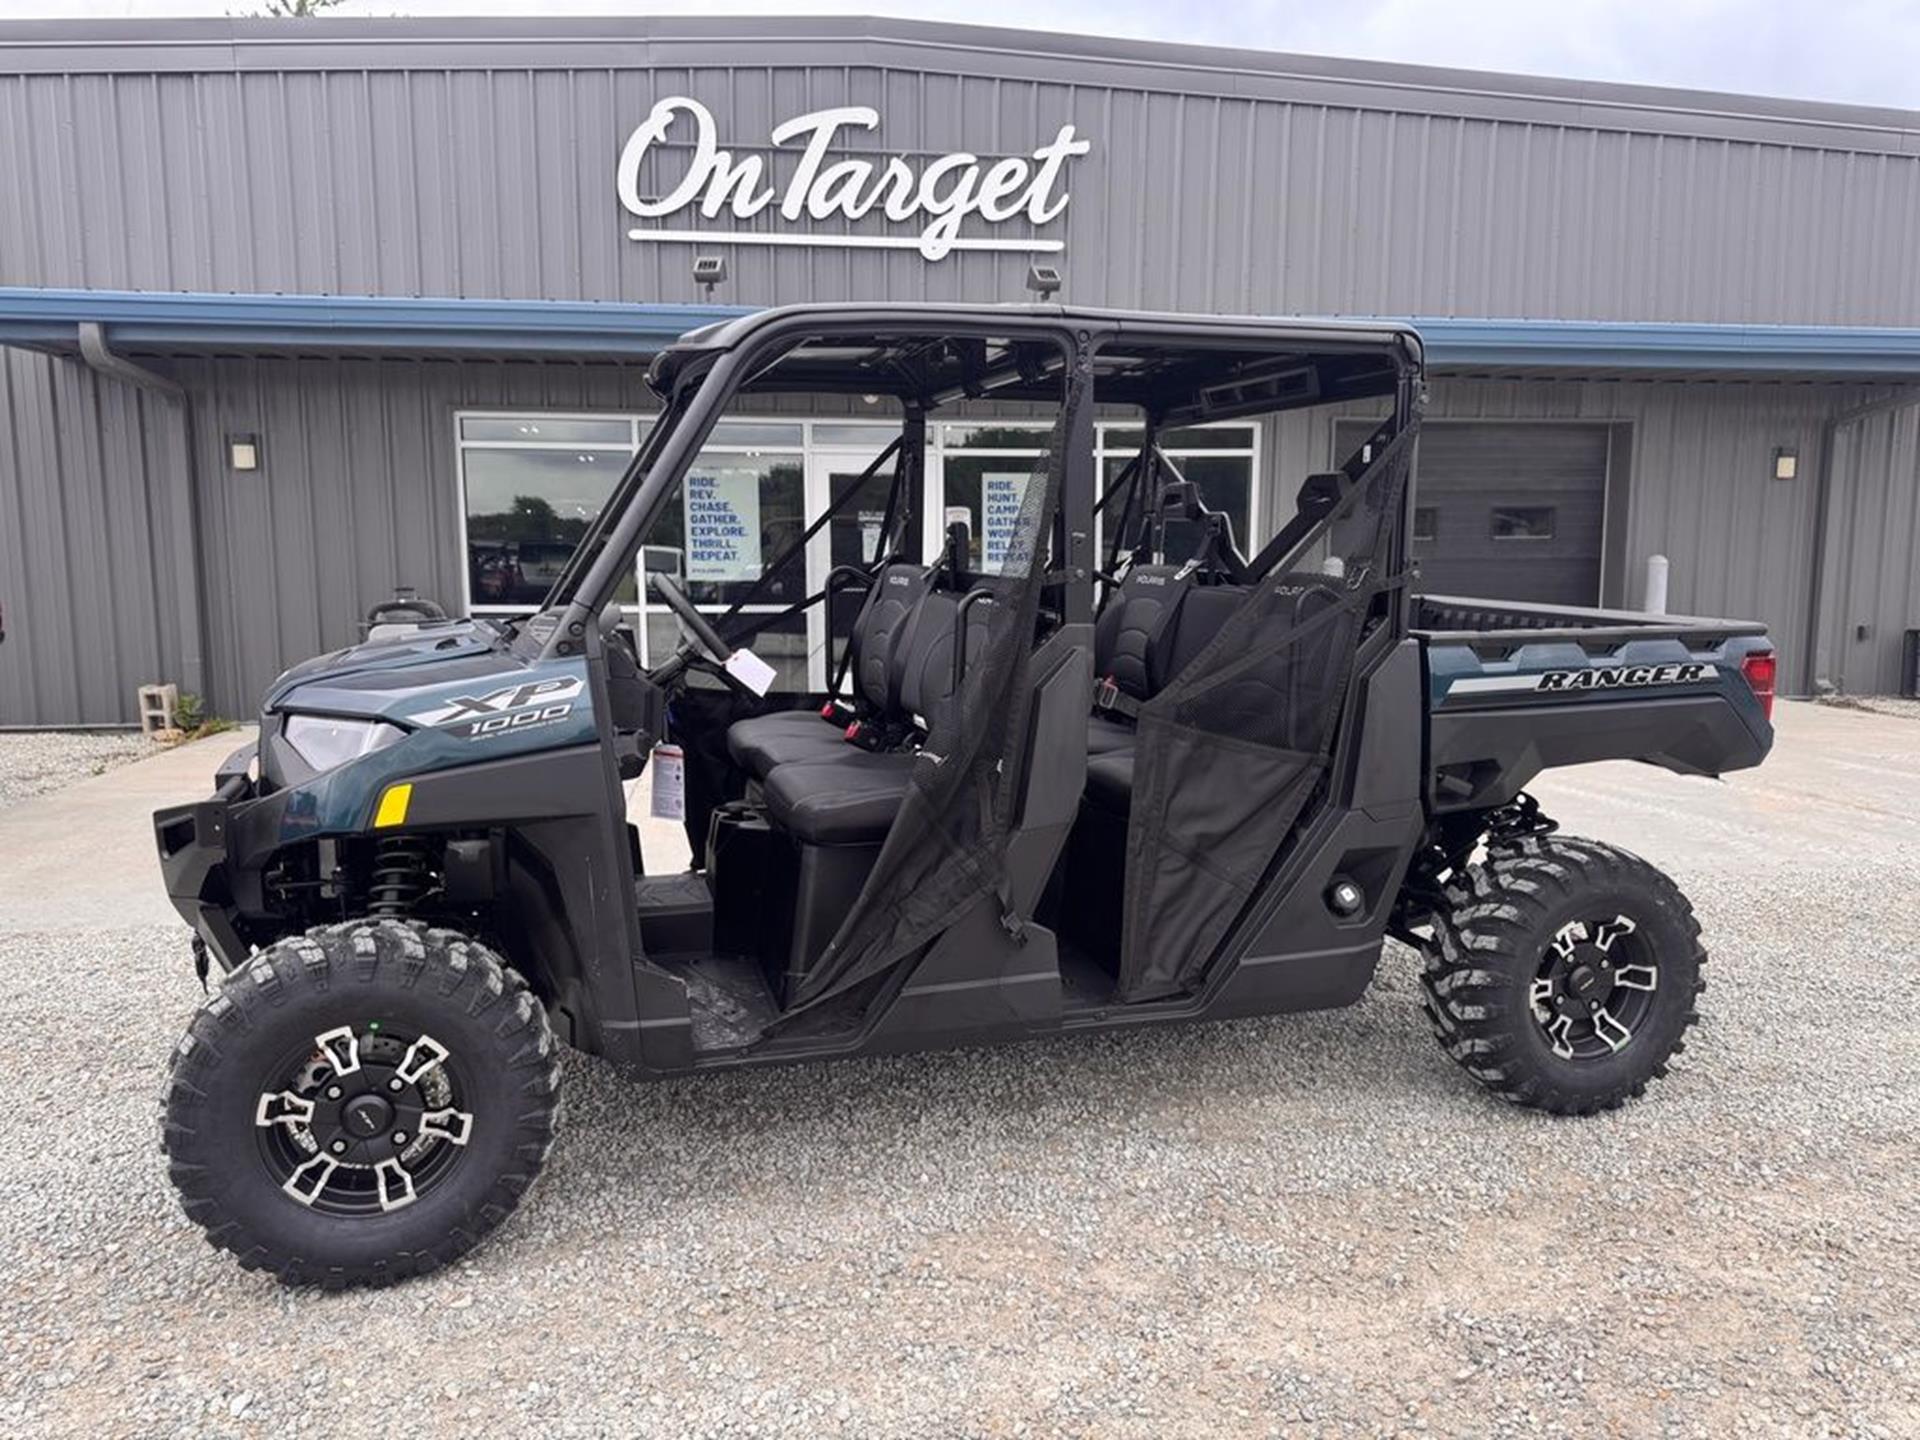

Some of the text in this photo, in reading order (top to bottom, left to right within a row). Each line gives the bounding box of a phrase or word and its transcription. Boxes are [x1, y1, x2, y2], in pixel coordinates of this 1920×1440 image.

[617, 96, 1091, 260] On Target
[689, 477, 720, 487] RIDE.
[987, 481, 1014, 490] RIDE.
[689, 490, 717, 500] REV.
[689, 502, 733, 512] CHASE.
[690, 514, 741, 525] GATHER.
[691, 527, 749, 537] EXPLORE.
[691, 539, 737, 549] THRILL.
[1534, 662, 1706, 692] RANGER
[435, 674, 581, 723] XP
[470, 703, 573, 735] 1000
